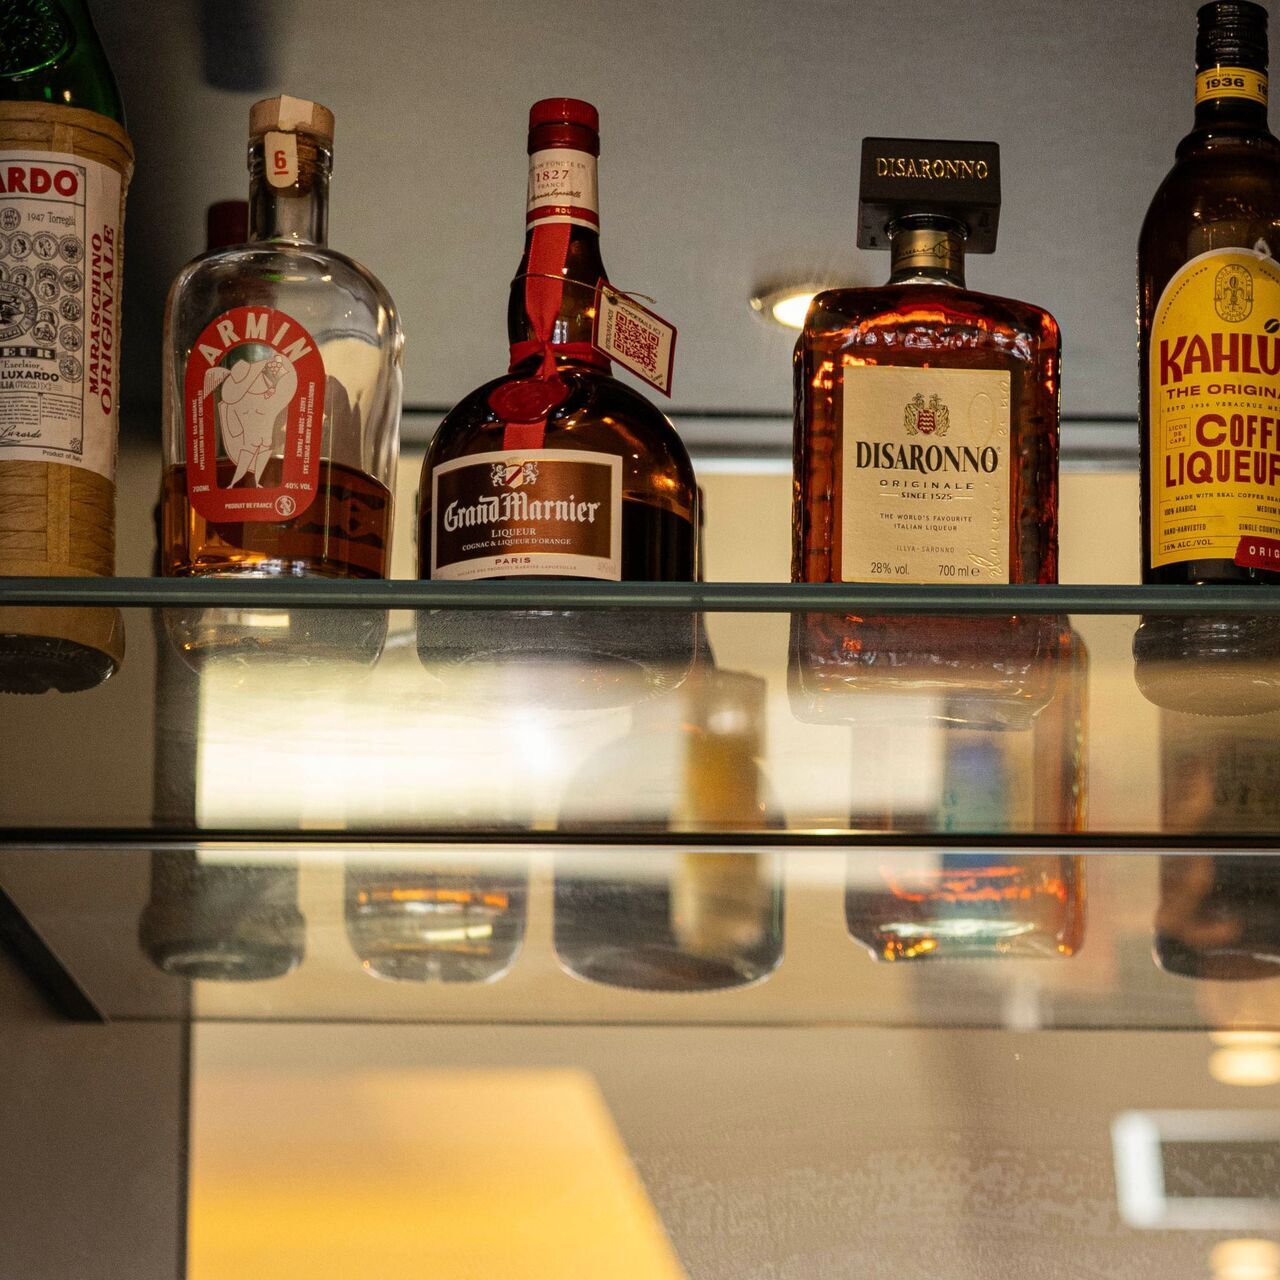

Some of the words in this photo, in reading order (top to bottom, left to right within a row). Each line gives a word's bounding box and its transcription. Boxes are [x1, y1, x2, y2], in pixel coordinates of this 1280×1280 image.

[1206, 77, 1244, 89] 1936
[273, 150, 288, 170] 6
[876, 157, 988, 180] DISARONNO
[535, 170, 569, 183] 1827
[89, 233, 102, 396] MARASCHINO
[101, 224, 114, 416] ORIGINALE
[199, 312, 312, 366] ARMIN
[1166, 386, 1200, 399] THE
[856, 441, 998, 474] DISARONNO
[880, 479, 973, 490] ORIGINALE
[444, 495, 501, 532] Grand
[500, 492, 600, 523] Marnier
[880, 512, 894, 520] THE
[897, 513, 929, 521] WORLD'S
[933, 514, 972, 522] FAVOURITE
[491, 528, 536, 538] LIQUEUR
[894, 523, 921, 531] ITALIAN
[924, 523, 957, 532] LIQUEUR
[462, 541, 489, 550] COGNAC
[498, 538, 530, 546] LIQUEUR
[495, 557, 531, 565] PARIS
